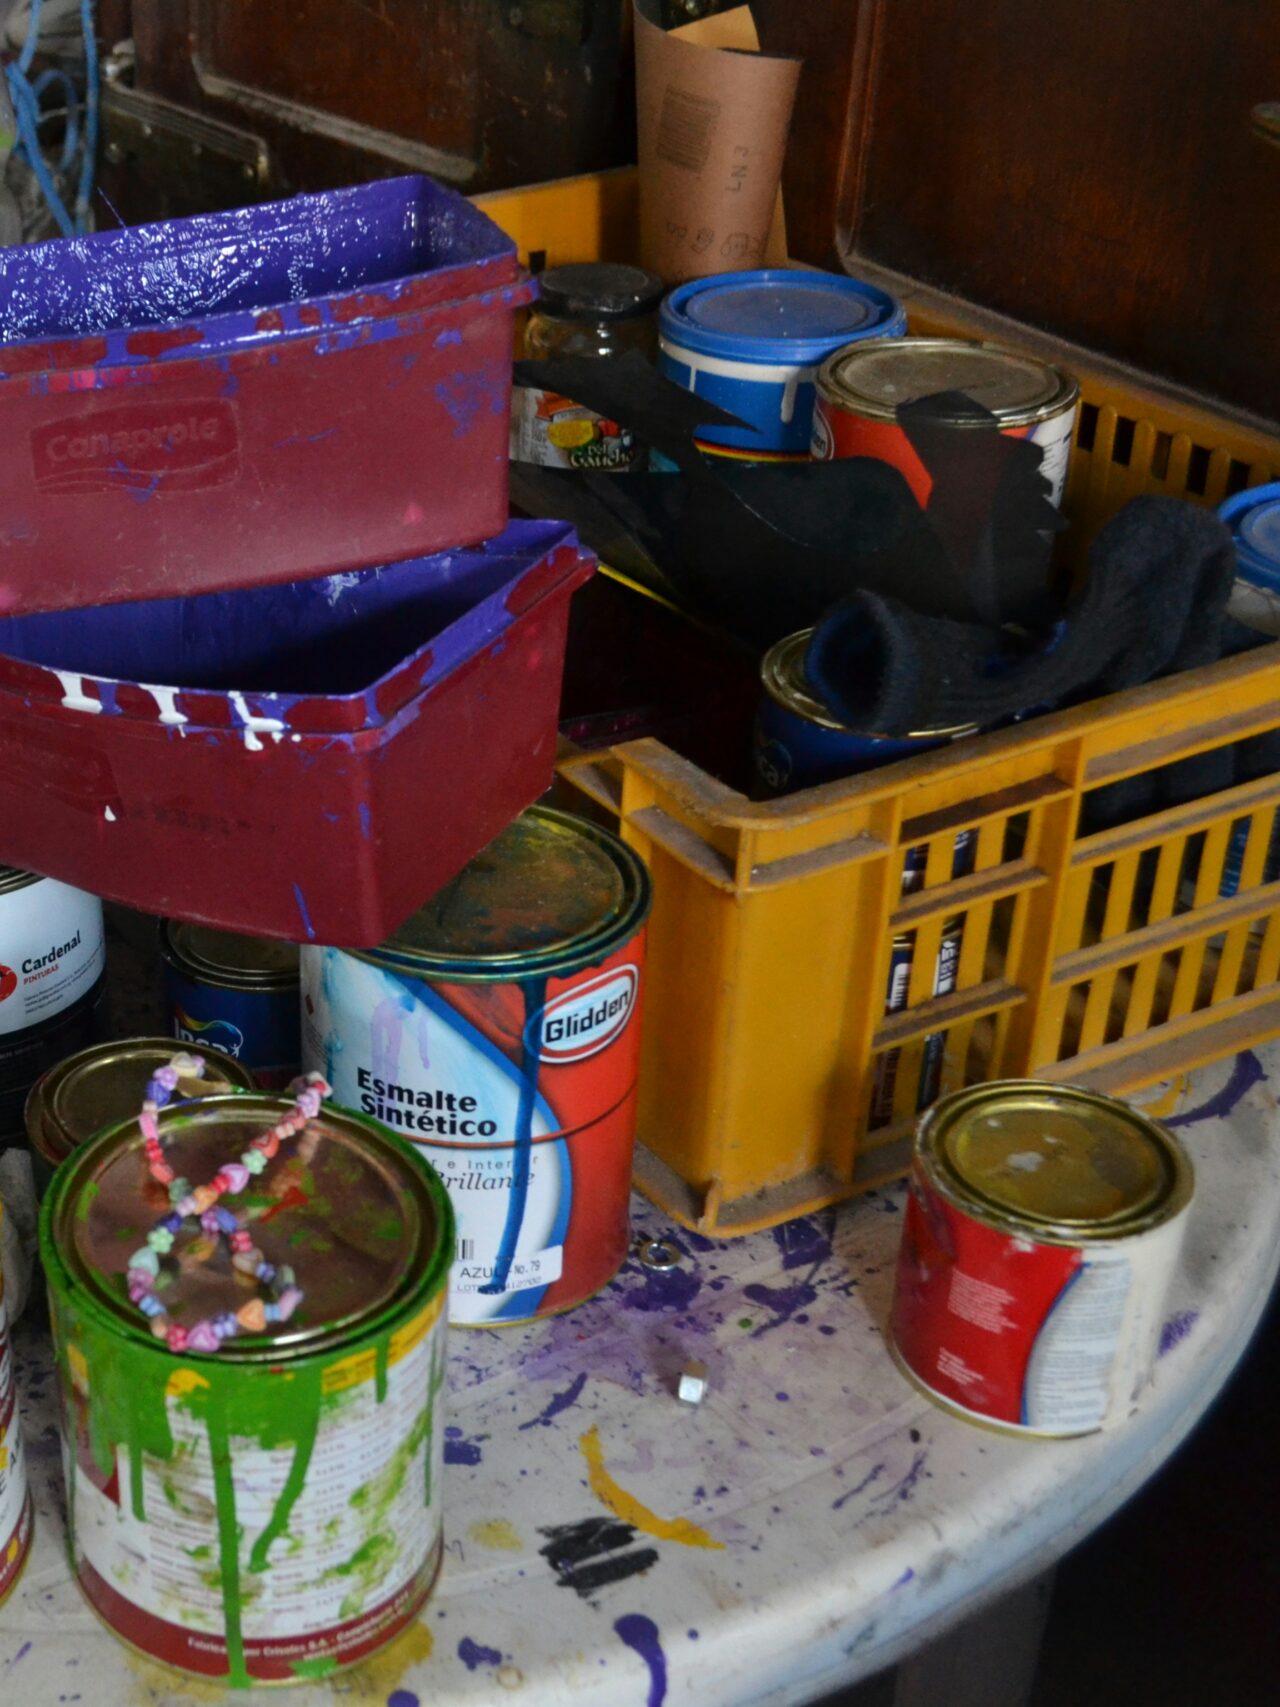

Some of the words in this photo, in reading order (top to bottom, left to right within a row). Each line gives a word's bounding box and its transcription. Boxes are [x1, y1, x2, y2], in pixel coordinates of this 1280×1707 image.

[21, 929, 82, 975] Cardenal
[23, 963, 60, 986] PINTURAS
[545, 989, 630, 1043] Glidden
[357, 1066, 477, 1113] Esmalte
[360, 1092, 497, 1137] Sintético
